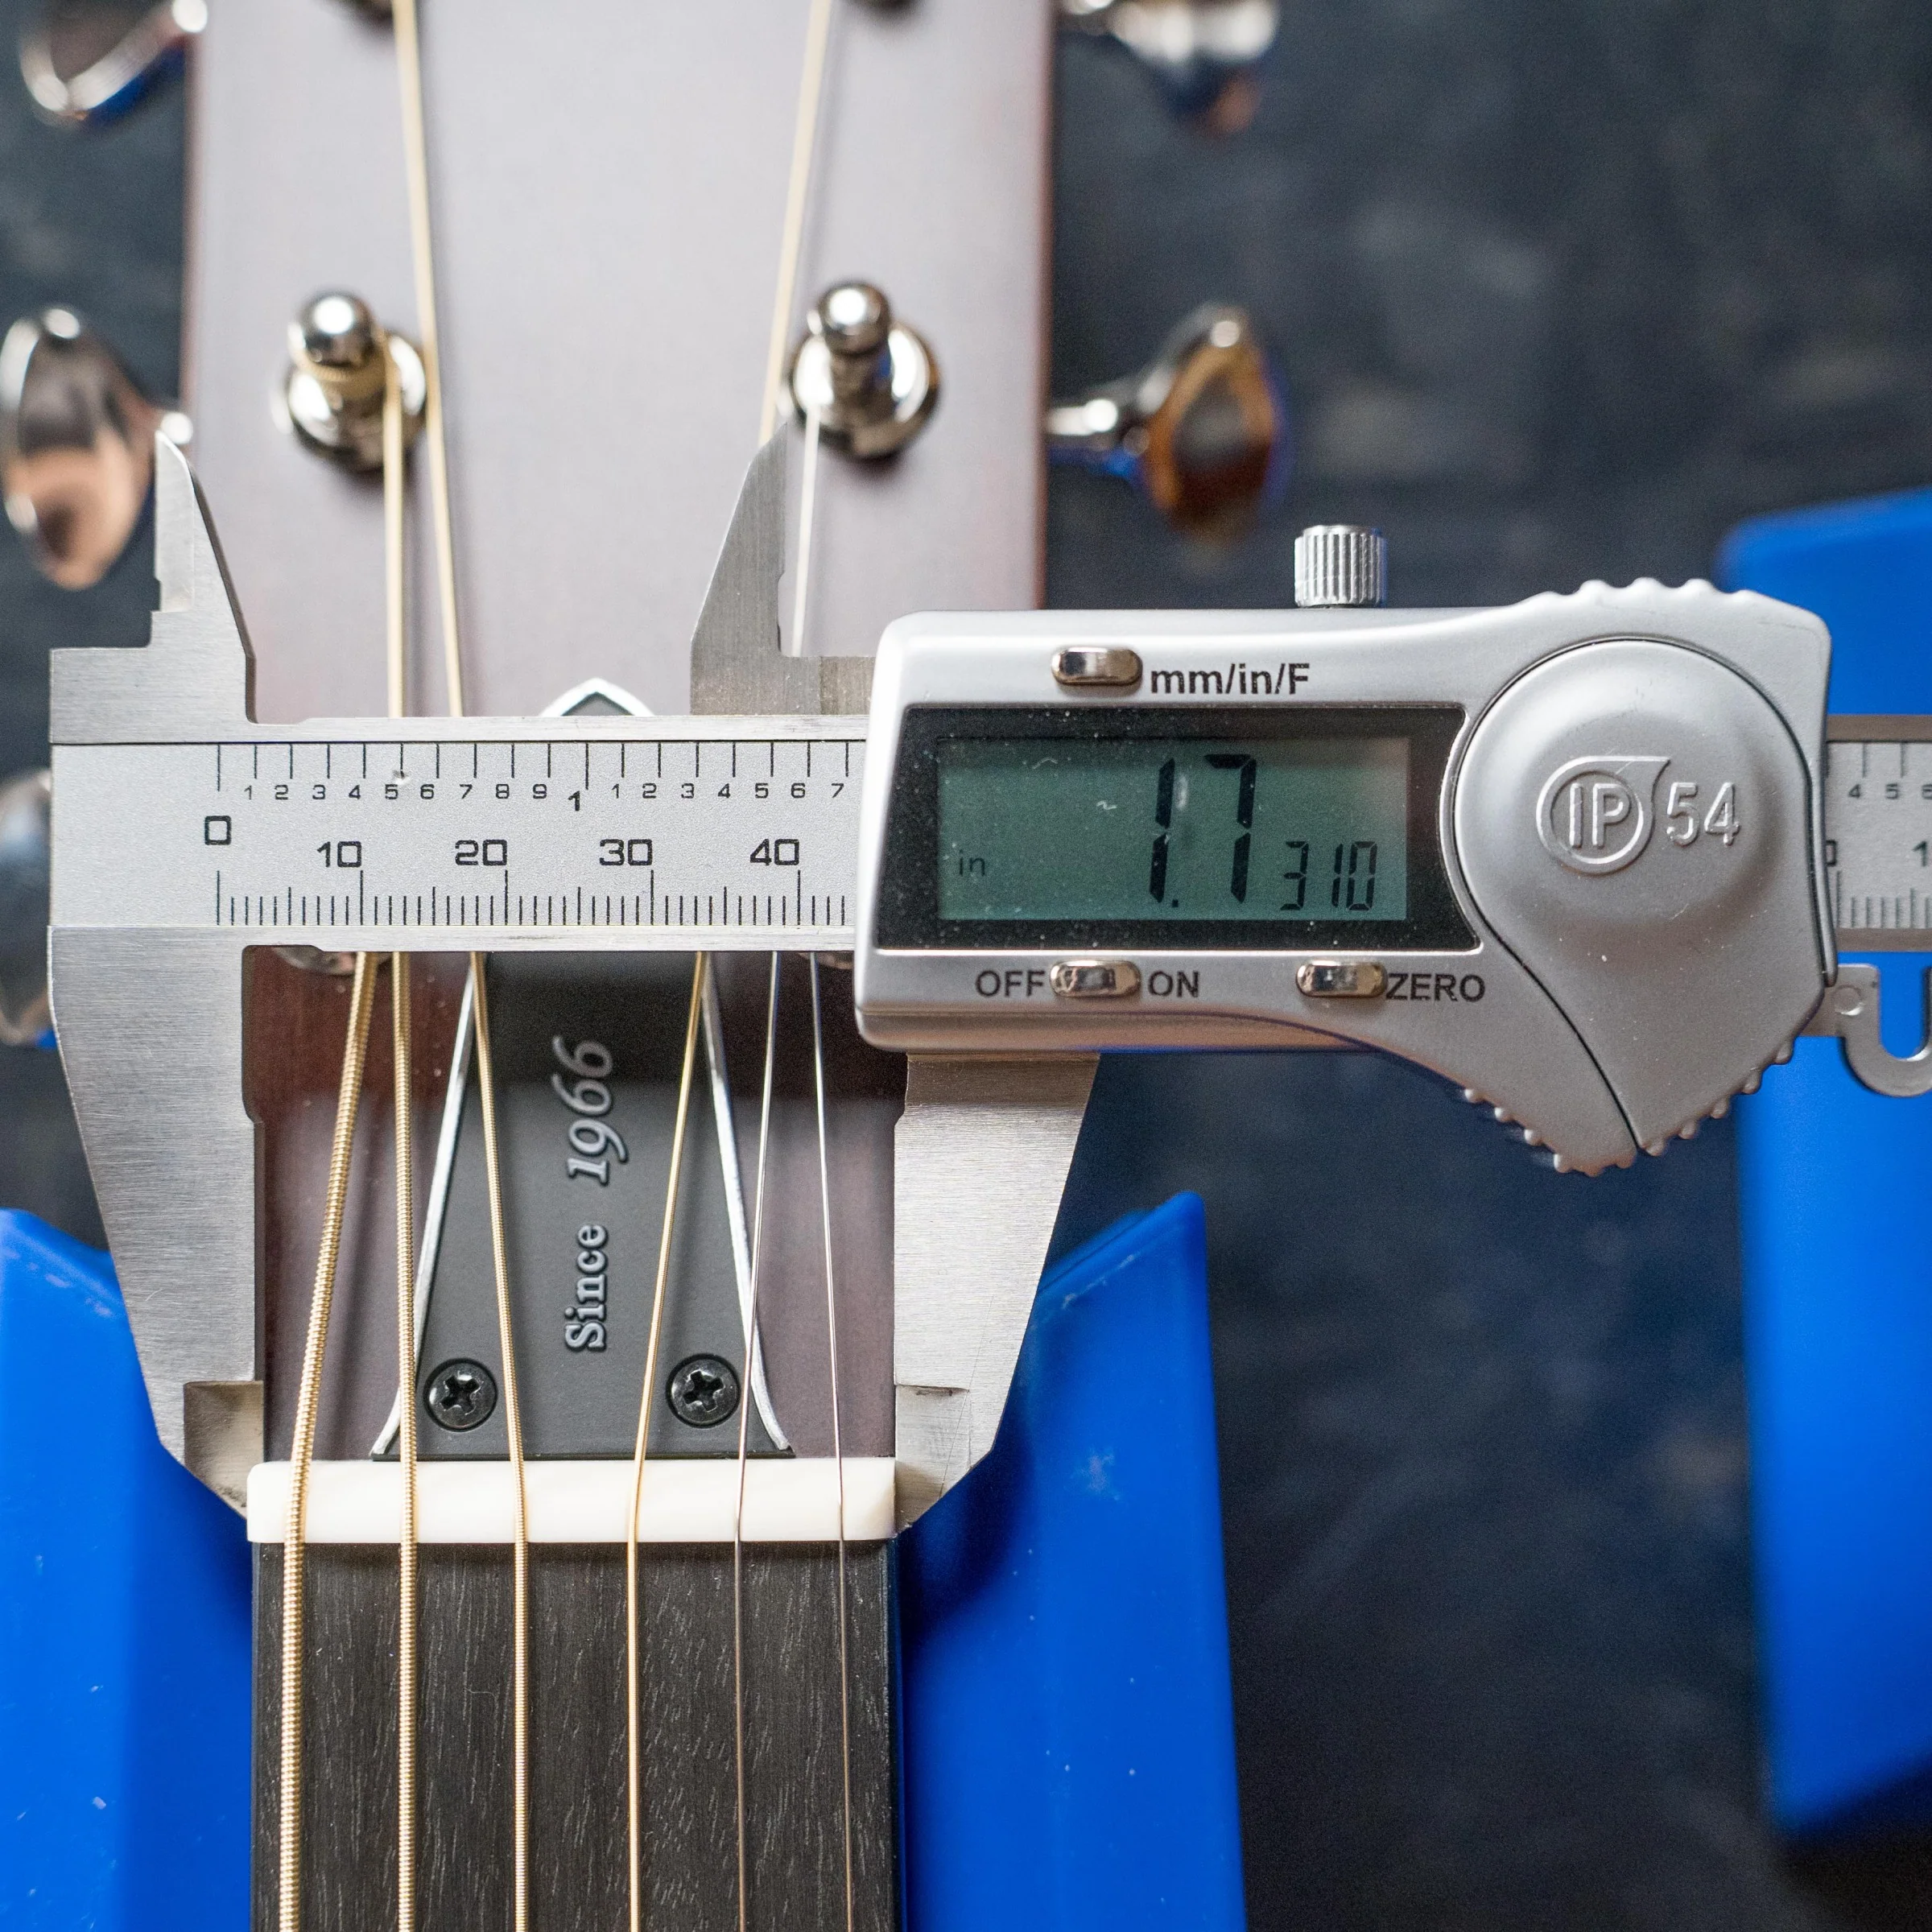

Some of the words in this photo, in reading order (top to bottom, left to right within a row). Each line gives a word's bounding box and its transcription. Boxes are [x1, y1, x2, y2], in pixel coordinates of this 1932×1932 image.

[1150, 662, 1311, 697] mm/in/F
[244, 785, 253, 800] 1
[275, 784, 289, 800] 2
[312, 784, 326, 800] 3
[349, 784, 361, 800] 4
[385, 784, 398, 800] 5
[420, 784, 435, 800] 6
[460, 784, 473, 800] 7
[495, 783, 510, 800] 8
[532, 783, 547, 799] 9
[568, 791, 580, 811] 1
[612, 783, 620, 799] 1
[642, 782, 658, 799] 2
[681, 782, 695, 799] 3
[717, 782, 731, 799] 4
[755, 782, 769, 799] 5
[791, 782, 806, 799] 6
[832, 782, 844, 799] 7
[1847, 783, 1861, 799] 4
[1885, 783, 1901, 800] 5
[1566, 782, 1632, 848] IP
[1665, 781, 1741, 847] 54
[204, 815, 231, 845] 0
[316, 840, 362, 868] 10
[454, 839, 508, 866] 20
[599, 838, 653, 866] 30
[749, 838, 800, 866] 40
[958, 849, 987, 877] in
[975, 971, 1046, 998] OFF
[1148, 971, 1199, 997] ON
[1386, 973, 1486, 1002] ZERO
[551, 1034, 630, 1186] 1966
[564, 1223, 610, 1352] Since
